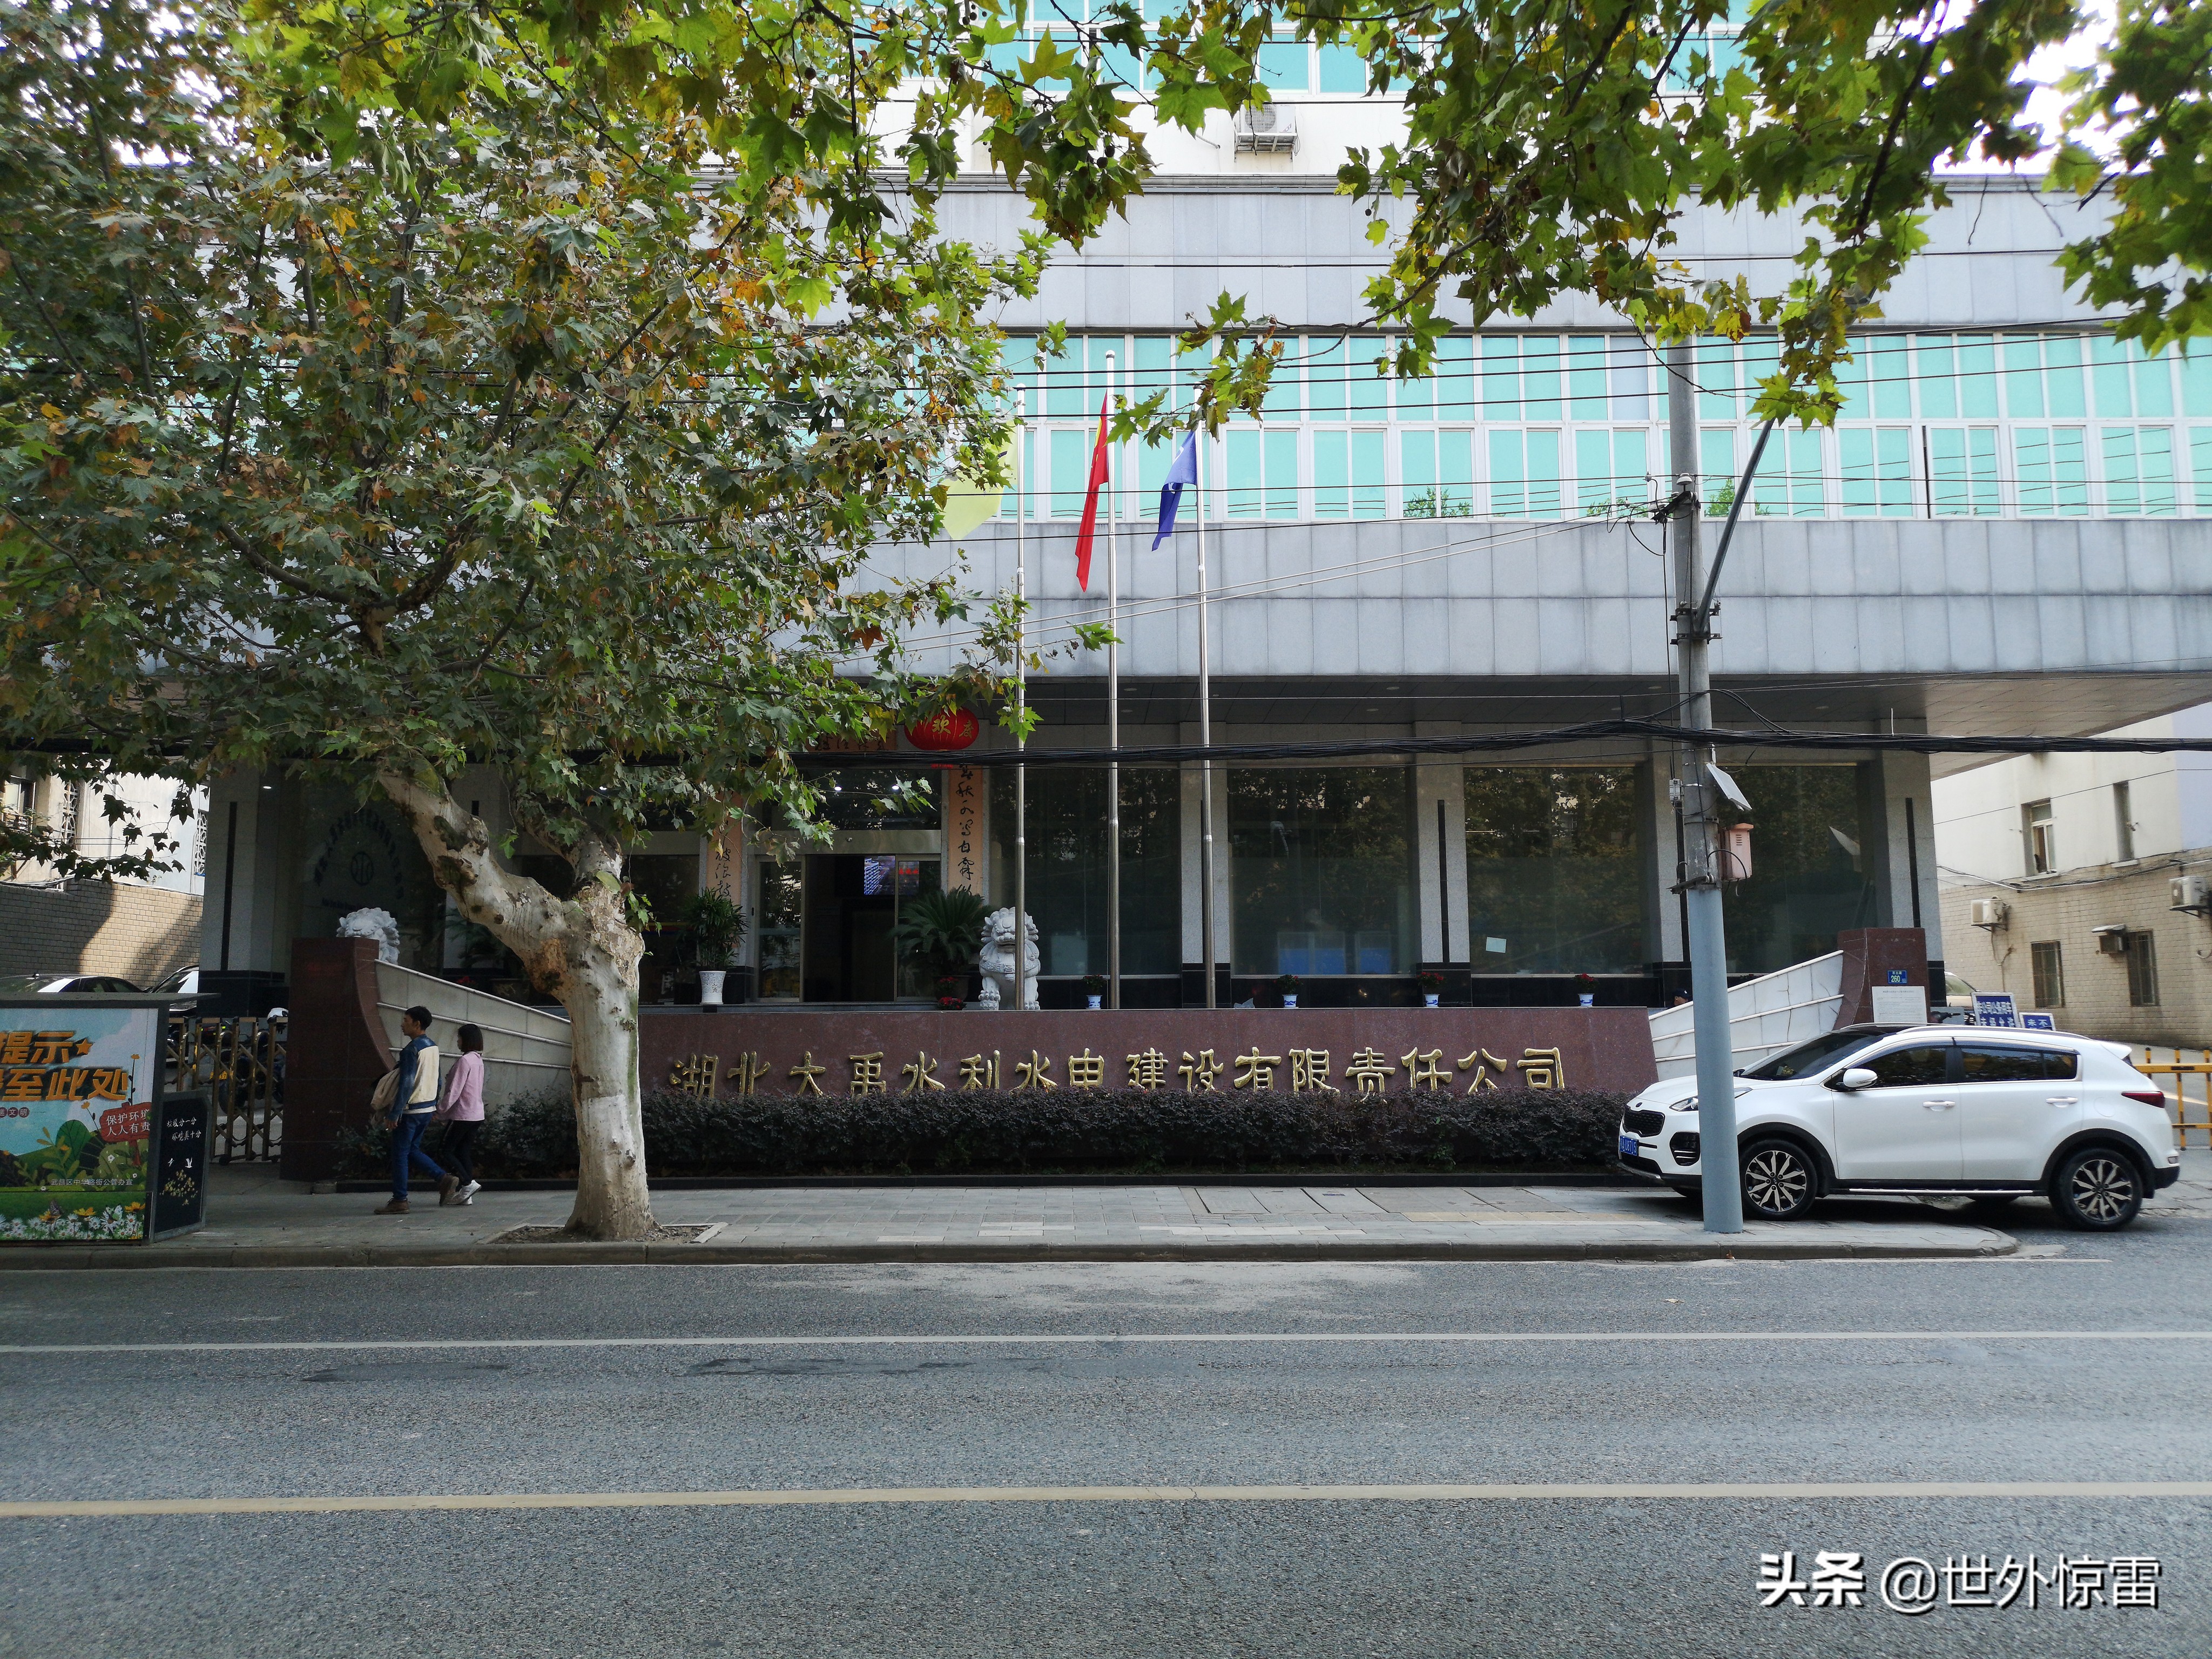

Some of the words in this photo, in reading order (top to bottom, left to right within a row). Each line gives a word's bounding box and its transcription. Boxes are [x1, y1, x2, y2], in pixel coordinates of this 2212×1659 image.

[0, 1069, 128, 1100] 至此处
[107, 1122, 150, 1137] 人人有责
